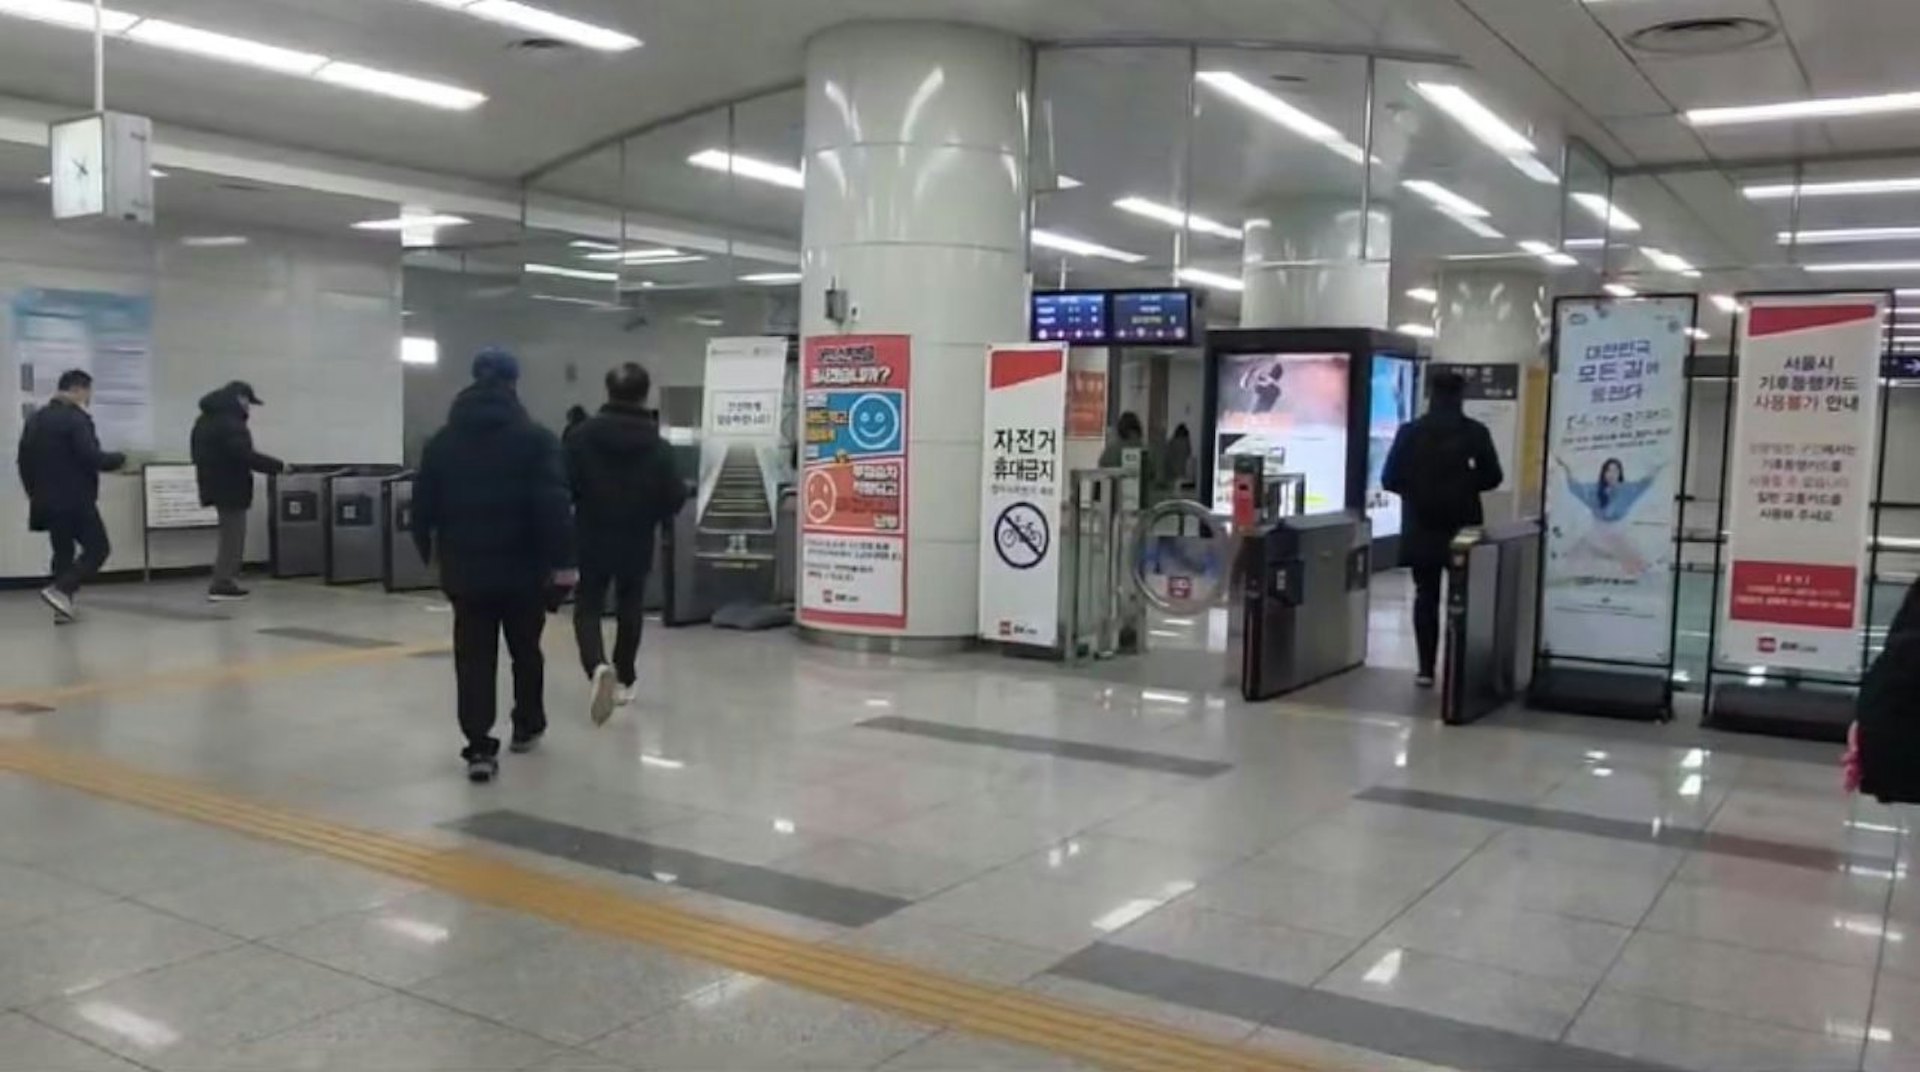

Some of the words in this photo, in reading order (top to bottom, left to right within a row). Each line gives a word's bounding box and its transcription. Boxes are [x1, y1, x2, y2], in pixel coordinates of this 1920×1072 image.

[1585, 340, 1651, 360] 대한민국
[1578, 361, 1618, 383] 모든
[1783, 355, 1834, 372] 서울시
[1759, 375, 1858, 392] 기후동행카드
[1825, 395, 1860, 413] 안내
[993, 427, 1056, 455] 자전거
[993, 457, 1055, 482] 휴대금지
